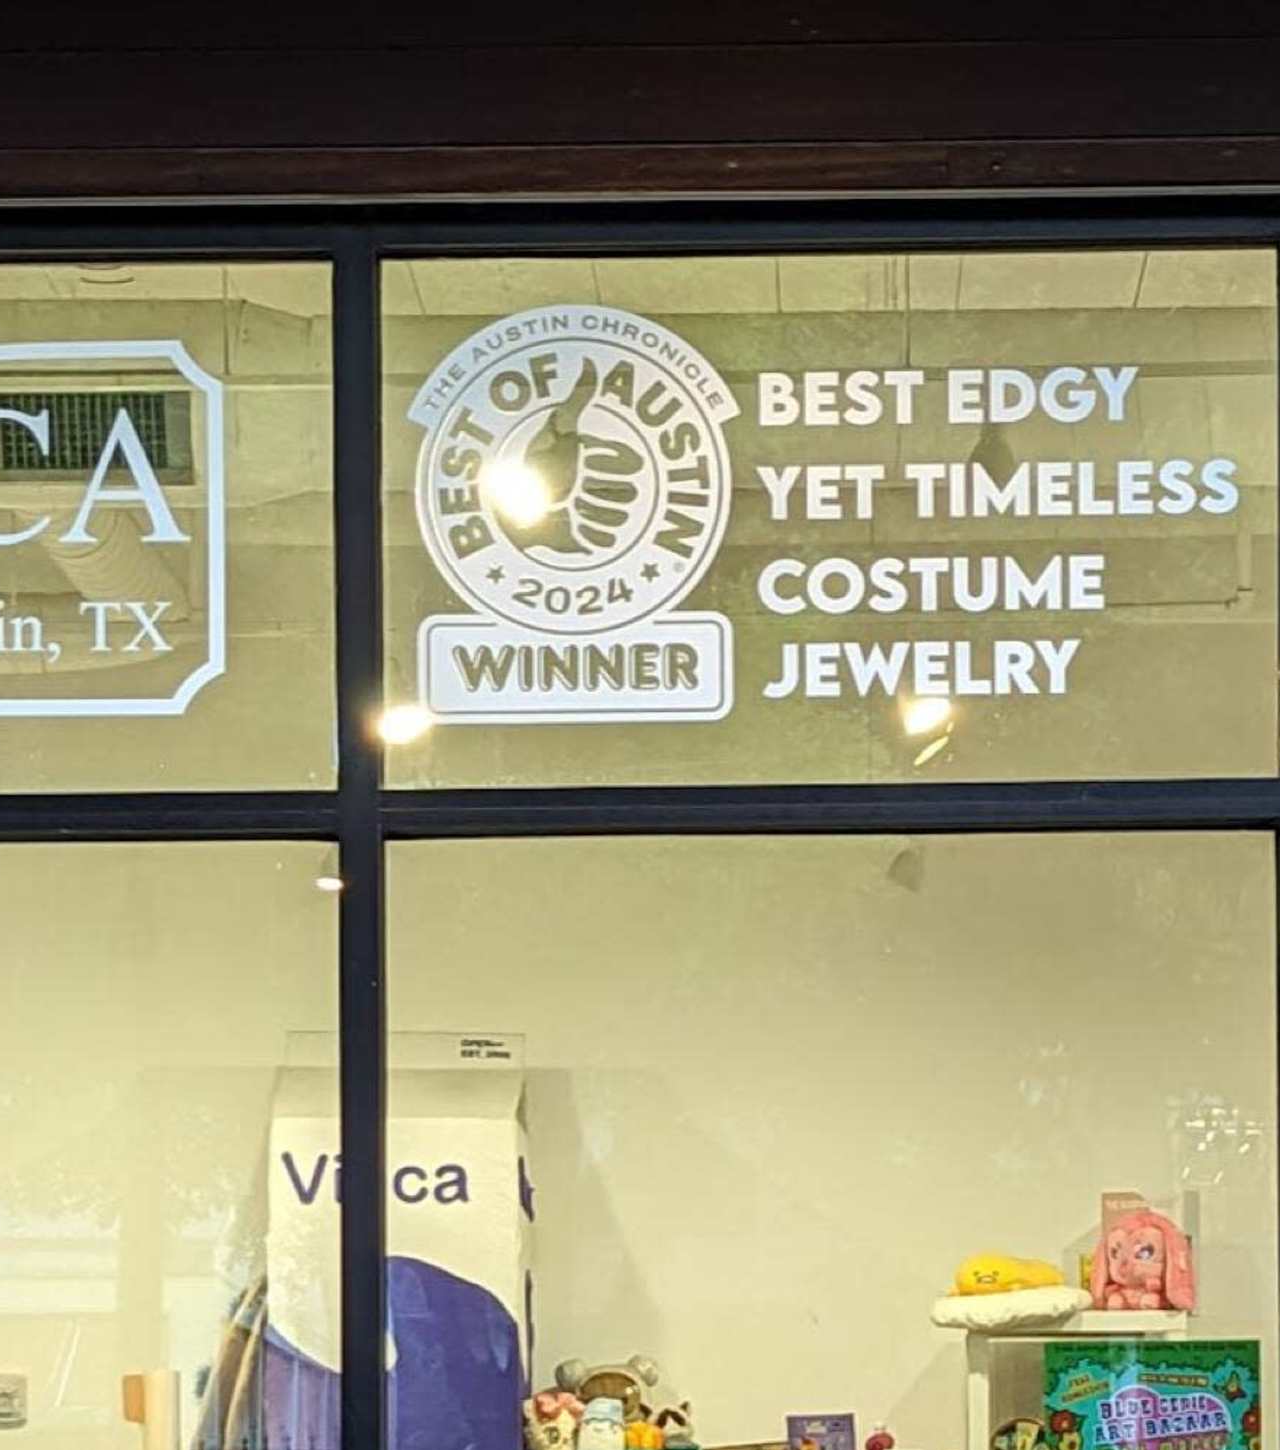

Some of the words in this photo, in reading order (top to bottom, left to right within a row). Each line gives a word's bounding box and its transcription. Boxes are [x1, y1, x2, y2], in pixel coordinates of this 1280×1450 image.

[423, 363, 467, 410] THE
[472, 314, 569, 362] AUSTIN
[581, 314, 725, 409] CHRONICLE
[759, 369, 924, 427] BEST
[946, 365, 1138, 425] EDGY
[439, 406, 496, 560] BEST
[489, 353, 559, 413] OF
[601, 359, 710, 560] AUSTIN
[757, 465, 884, 521] YET
[905, 457, 1240, 519] TIMELESS
[513, 578, 634, 615] 2024
[757, 554, 1105, 615] COSTUME
[81, 601, 174, 653] TX
[452, 643, 699, 692] WINNER
[763, 638, 1082, 699] JEWELRY
[280, 1151, 470, 1206] Vica
